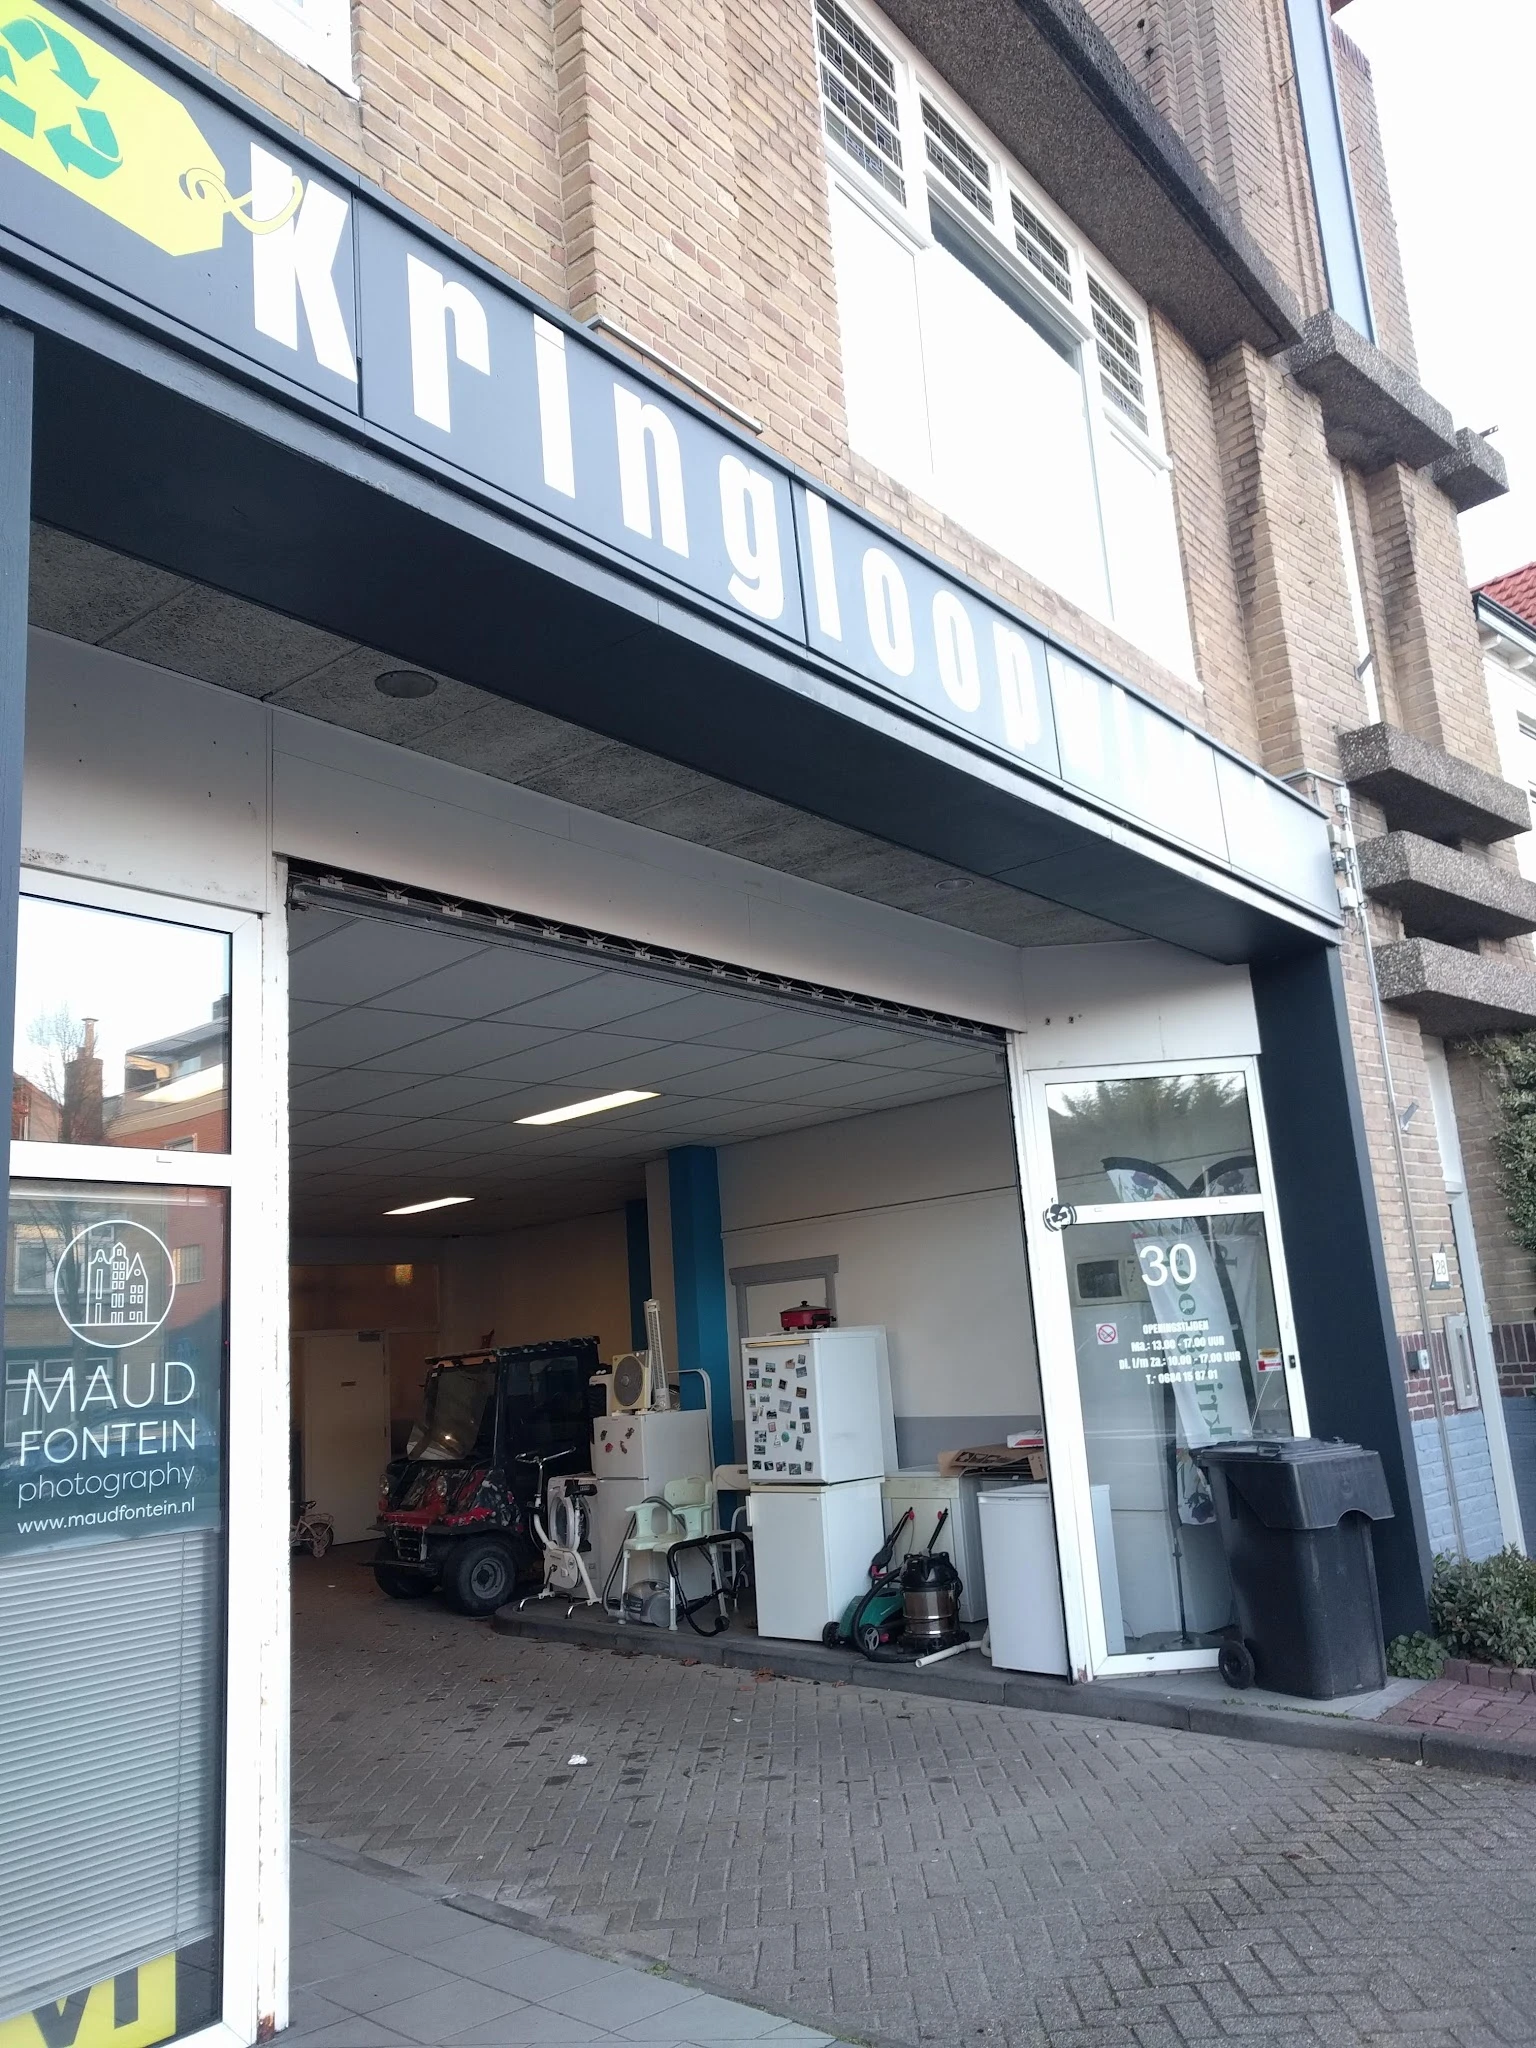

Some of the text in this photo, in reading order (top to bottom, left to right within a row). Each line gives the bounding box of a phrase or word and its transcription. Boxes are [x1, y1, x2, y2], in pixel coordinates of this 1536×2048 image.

[250, 142, 1280, 880] Kringloopwi
[1139, 1243, 1197, 1288] 30
[1435, 1259, 1447, 1275] 28
[1142, 1320, 1209, 1335] OPENINGSTIJDEN
[1207, 1335, 1225, 1346] UUR
[1223, 1350, 1241, 1362] UUR
[22, 1361, 196, 1416] MAUD
[19, 1418, 196, 1467] FONTEIN
[18, 1461, 196, 1509] photography
[17, 1497, 196, 1534] www.maudfontein.nl
